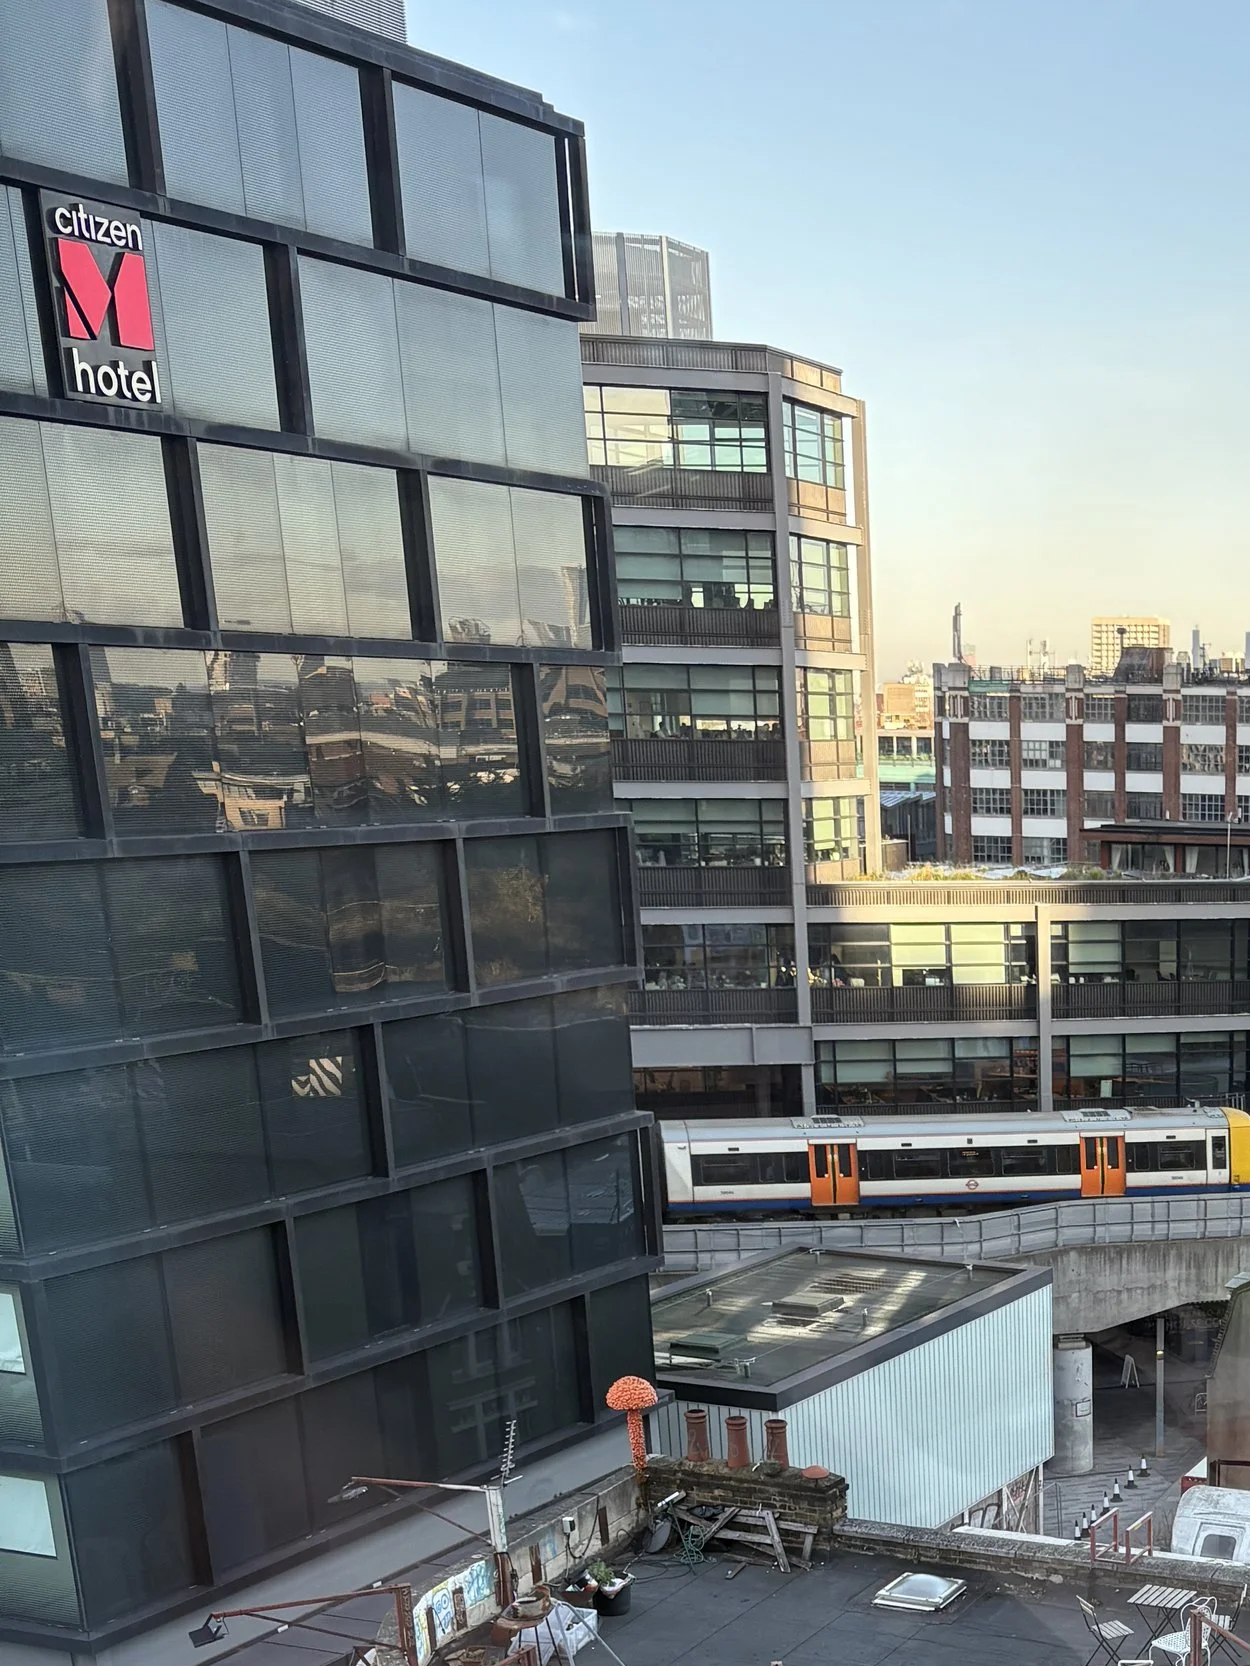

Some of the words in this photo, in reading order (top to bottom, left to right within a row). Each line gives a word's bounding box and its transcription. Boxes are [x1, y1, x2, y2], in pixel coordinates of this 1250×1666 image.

[54, 203, 143, 251] citizen
[57, 237, 155, 351] M
[71, 347, 161, 404] hotel
